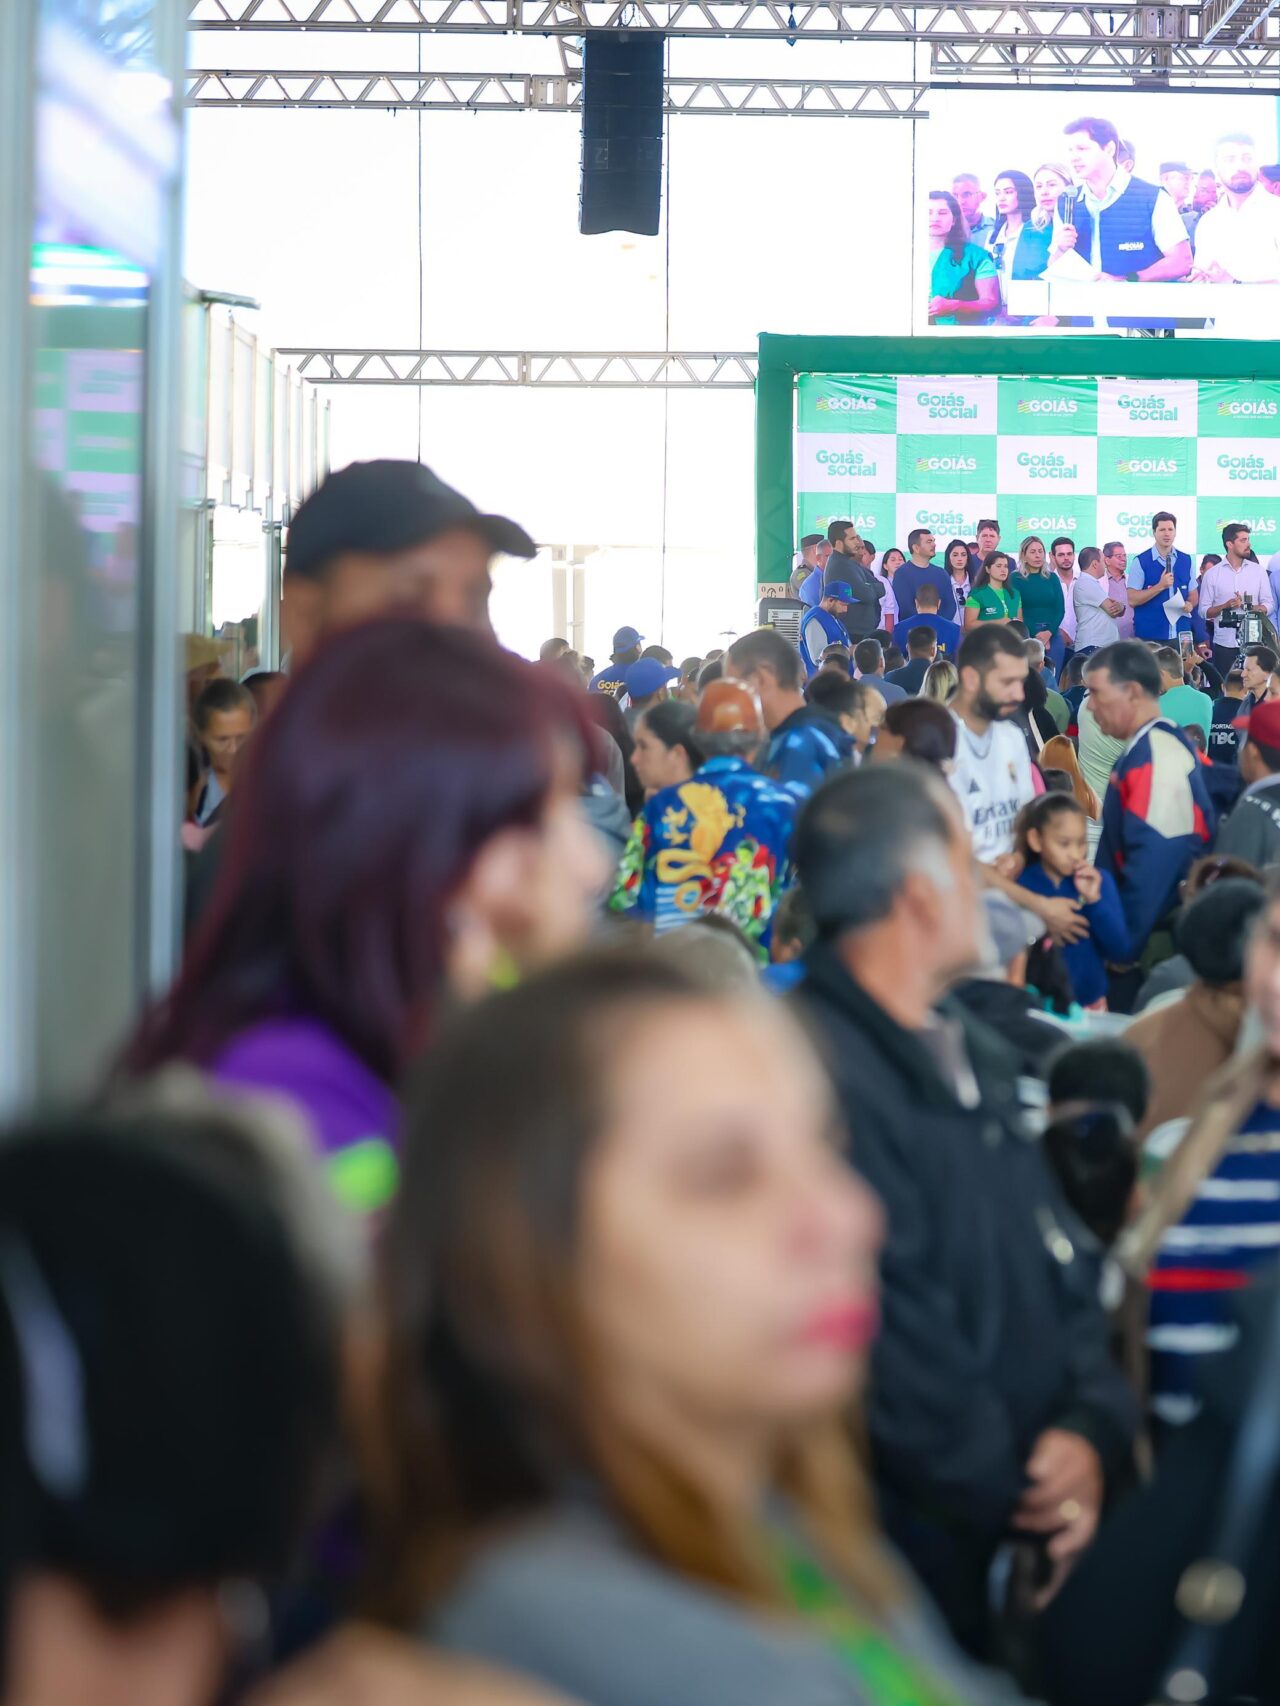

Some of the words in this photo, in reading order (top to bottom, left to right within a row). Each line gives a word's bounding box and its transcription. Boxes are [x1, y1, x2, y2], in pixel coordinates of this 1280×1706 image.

[828, 396, 877, 410] GOIÁS
[917, 392, 964, 407] Goiás
[1029, 398, 1078, 412] GOIÁS
[1118, 394, 1165, 409] Goiás
[928, 404, 977, 419] social
[1129, 407, 1178, 421] social
[1229, 400, 1278, 415] GOIÁS
[816, 450, 863, 464] Goiás
[928, 456, 976, 470] GOIÁS
[1017, 452, 1064, 466] Goiás
[1217, 454, 1264, 468] Goiás
[827, 462, 876, 476] social
[1029, 464, 1077, 478] social
[1128, 458, 1177, 472] GOIÁS
[1229, 466, 1277, 480] social
[916, 510, 963, 524] Goiás
[1029, 516, 1076, 529] GOIÁS
[1117, 512, 1153, 526] Goiá
[1210, 731, 1236, 745] TBC
